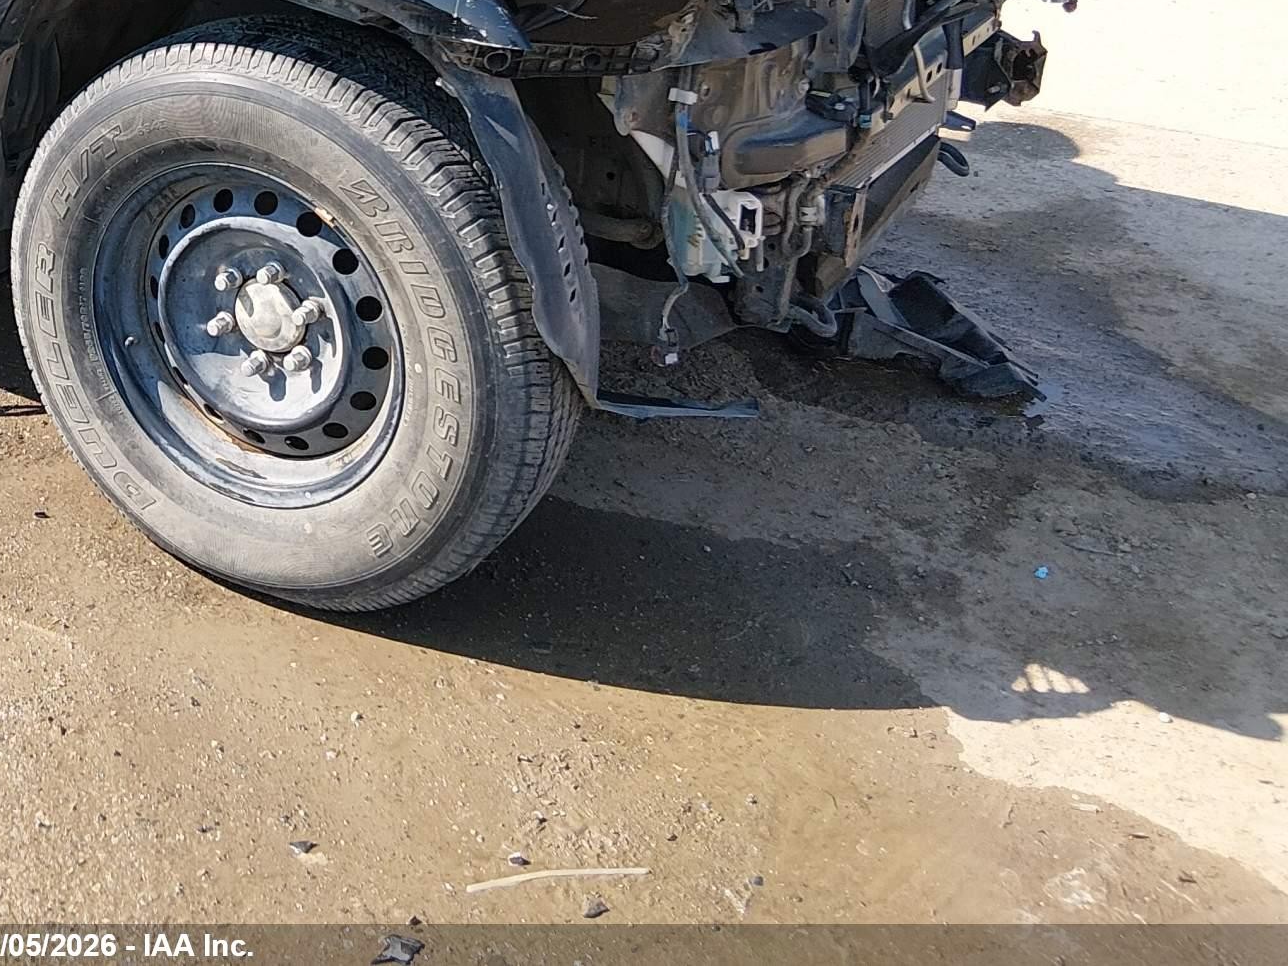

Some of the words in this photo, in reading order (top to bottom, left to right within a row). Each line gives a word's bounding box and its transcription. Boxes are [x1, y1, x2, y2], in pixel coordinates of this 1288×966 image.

[50, 124, 122, 220] H/T
[31, 243, 157, 512] DUELER
[339, 179, 462, 557] BRIDGESTONE
